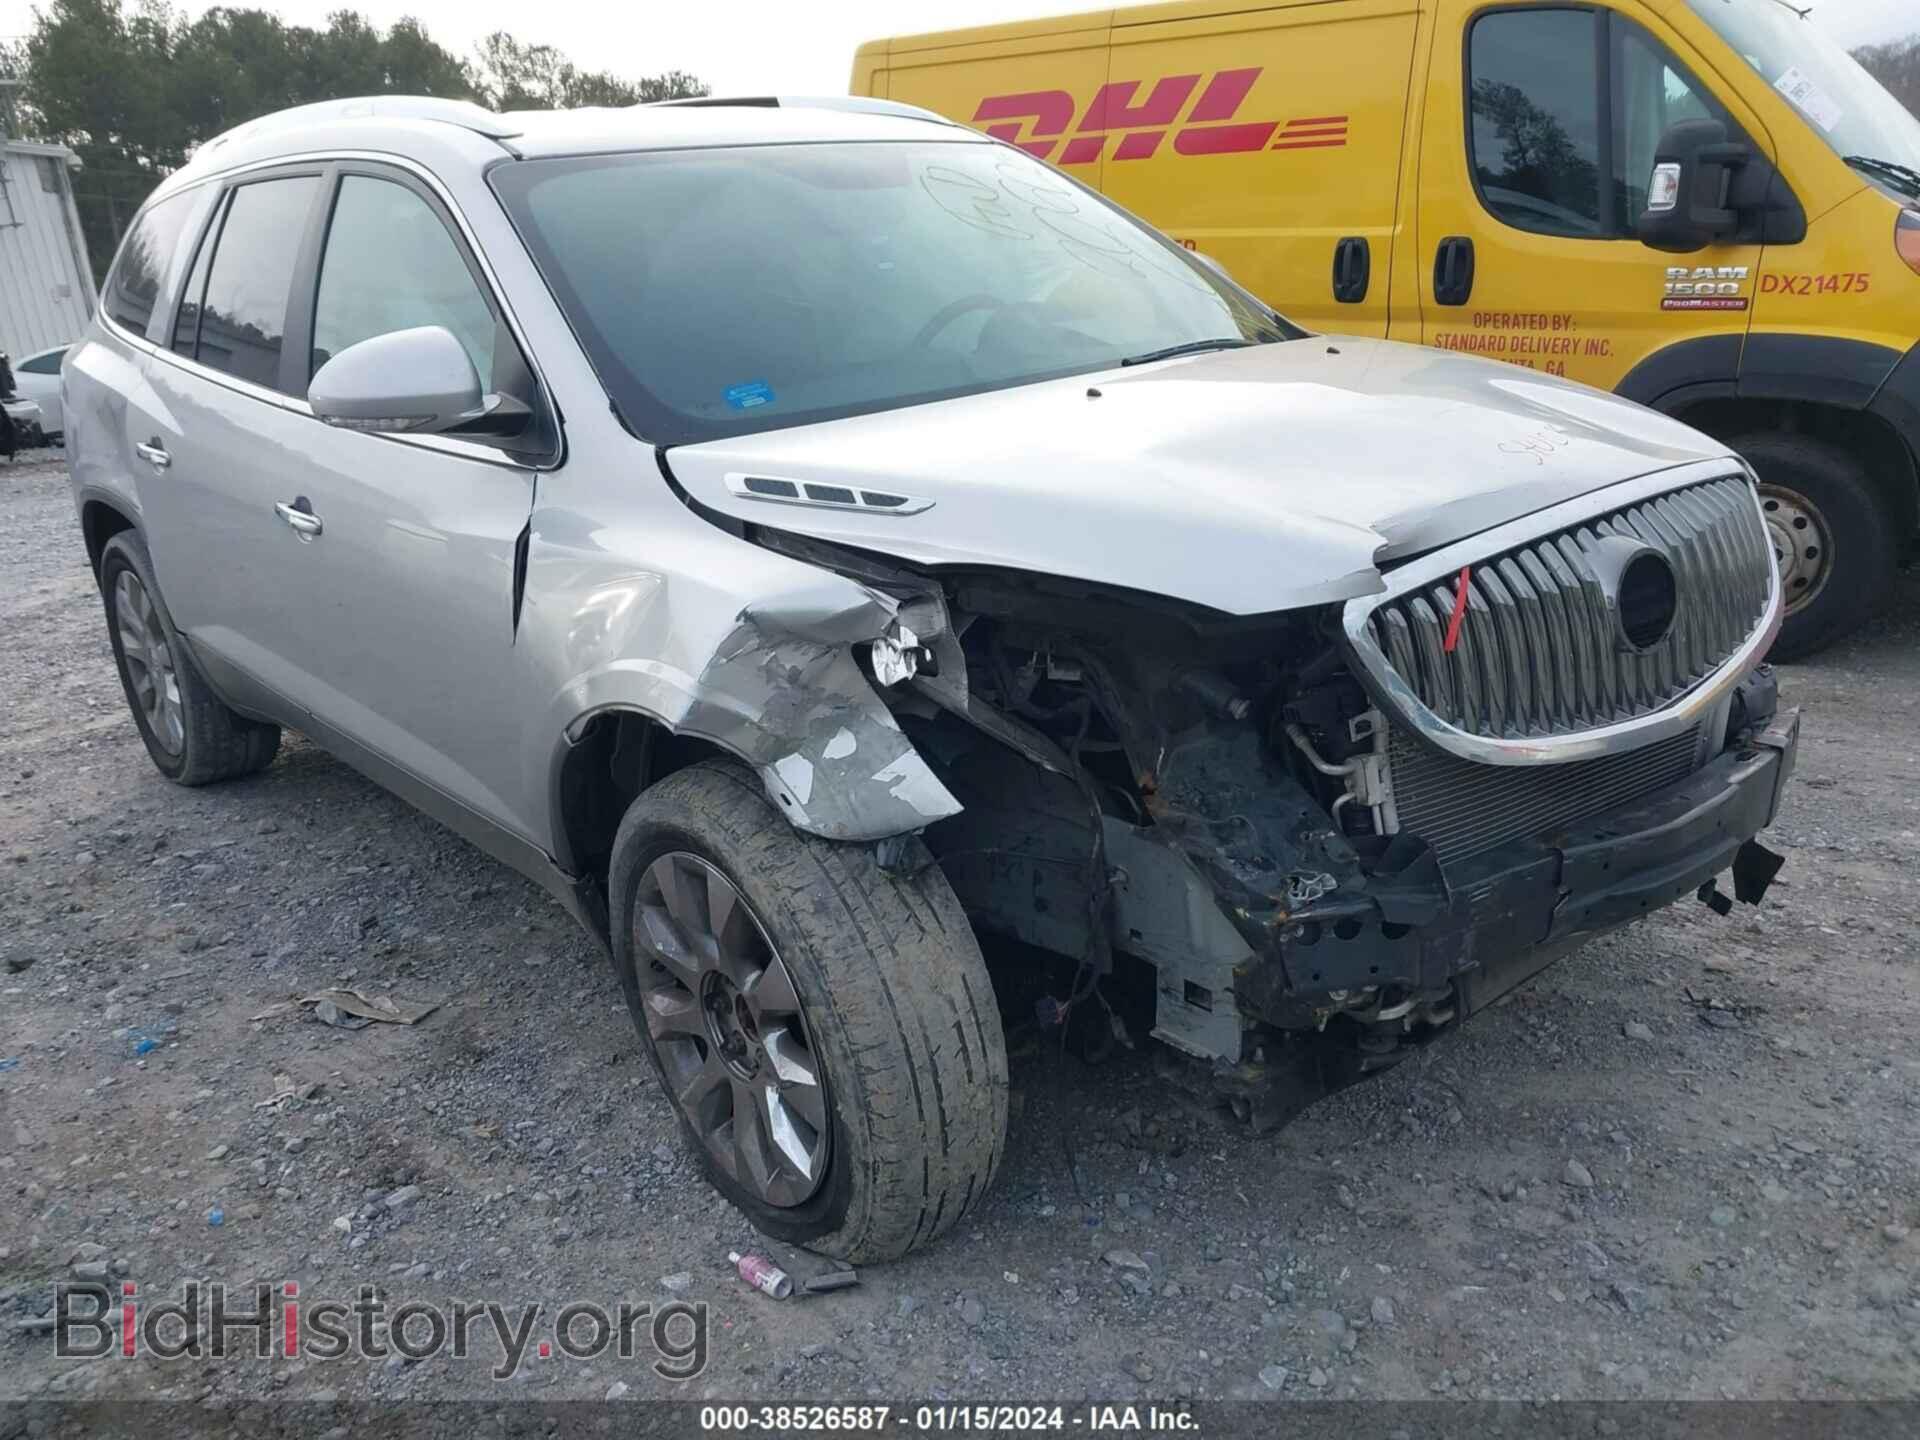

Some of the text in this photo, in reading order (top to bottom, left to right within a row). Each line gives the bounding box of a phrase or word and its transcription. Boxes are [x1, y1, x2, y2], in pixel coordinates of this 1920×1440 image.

[972, 67, 1280, 165] DHL
[1665, 266, 1749, 280] RAM
[1664, 282, 1739, 296] 1500
[1760, 273, 1870, 295] DX21475
[1473, 312, 1577, 331] OPERATED BY:
[1434, 333, 1615, 357] STANDARD DELIVERY INC.
[1545, 360, 1565, 377] GA
